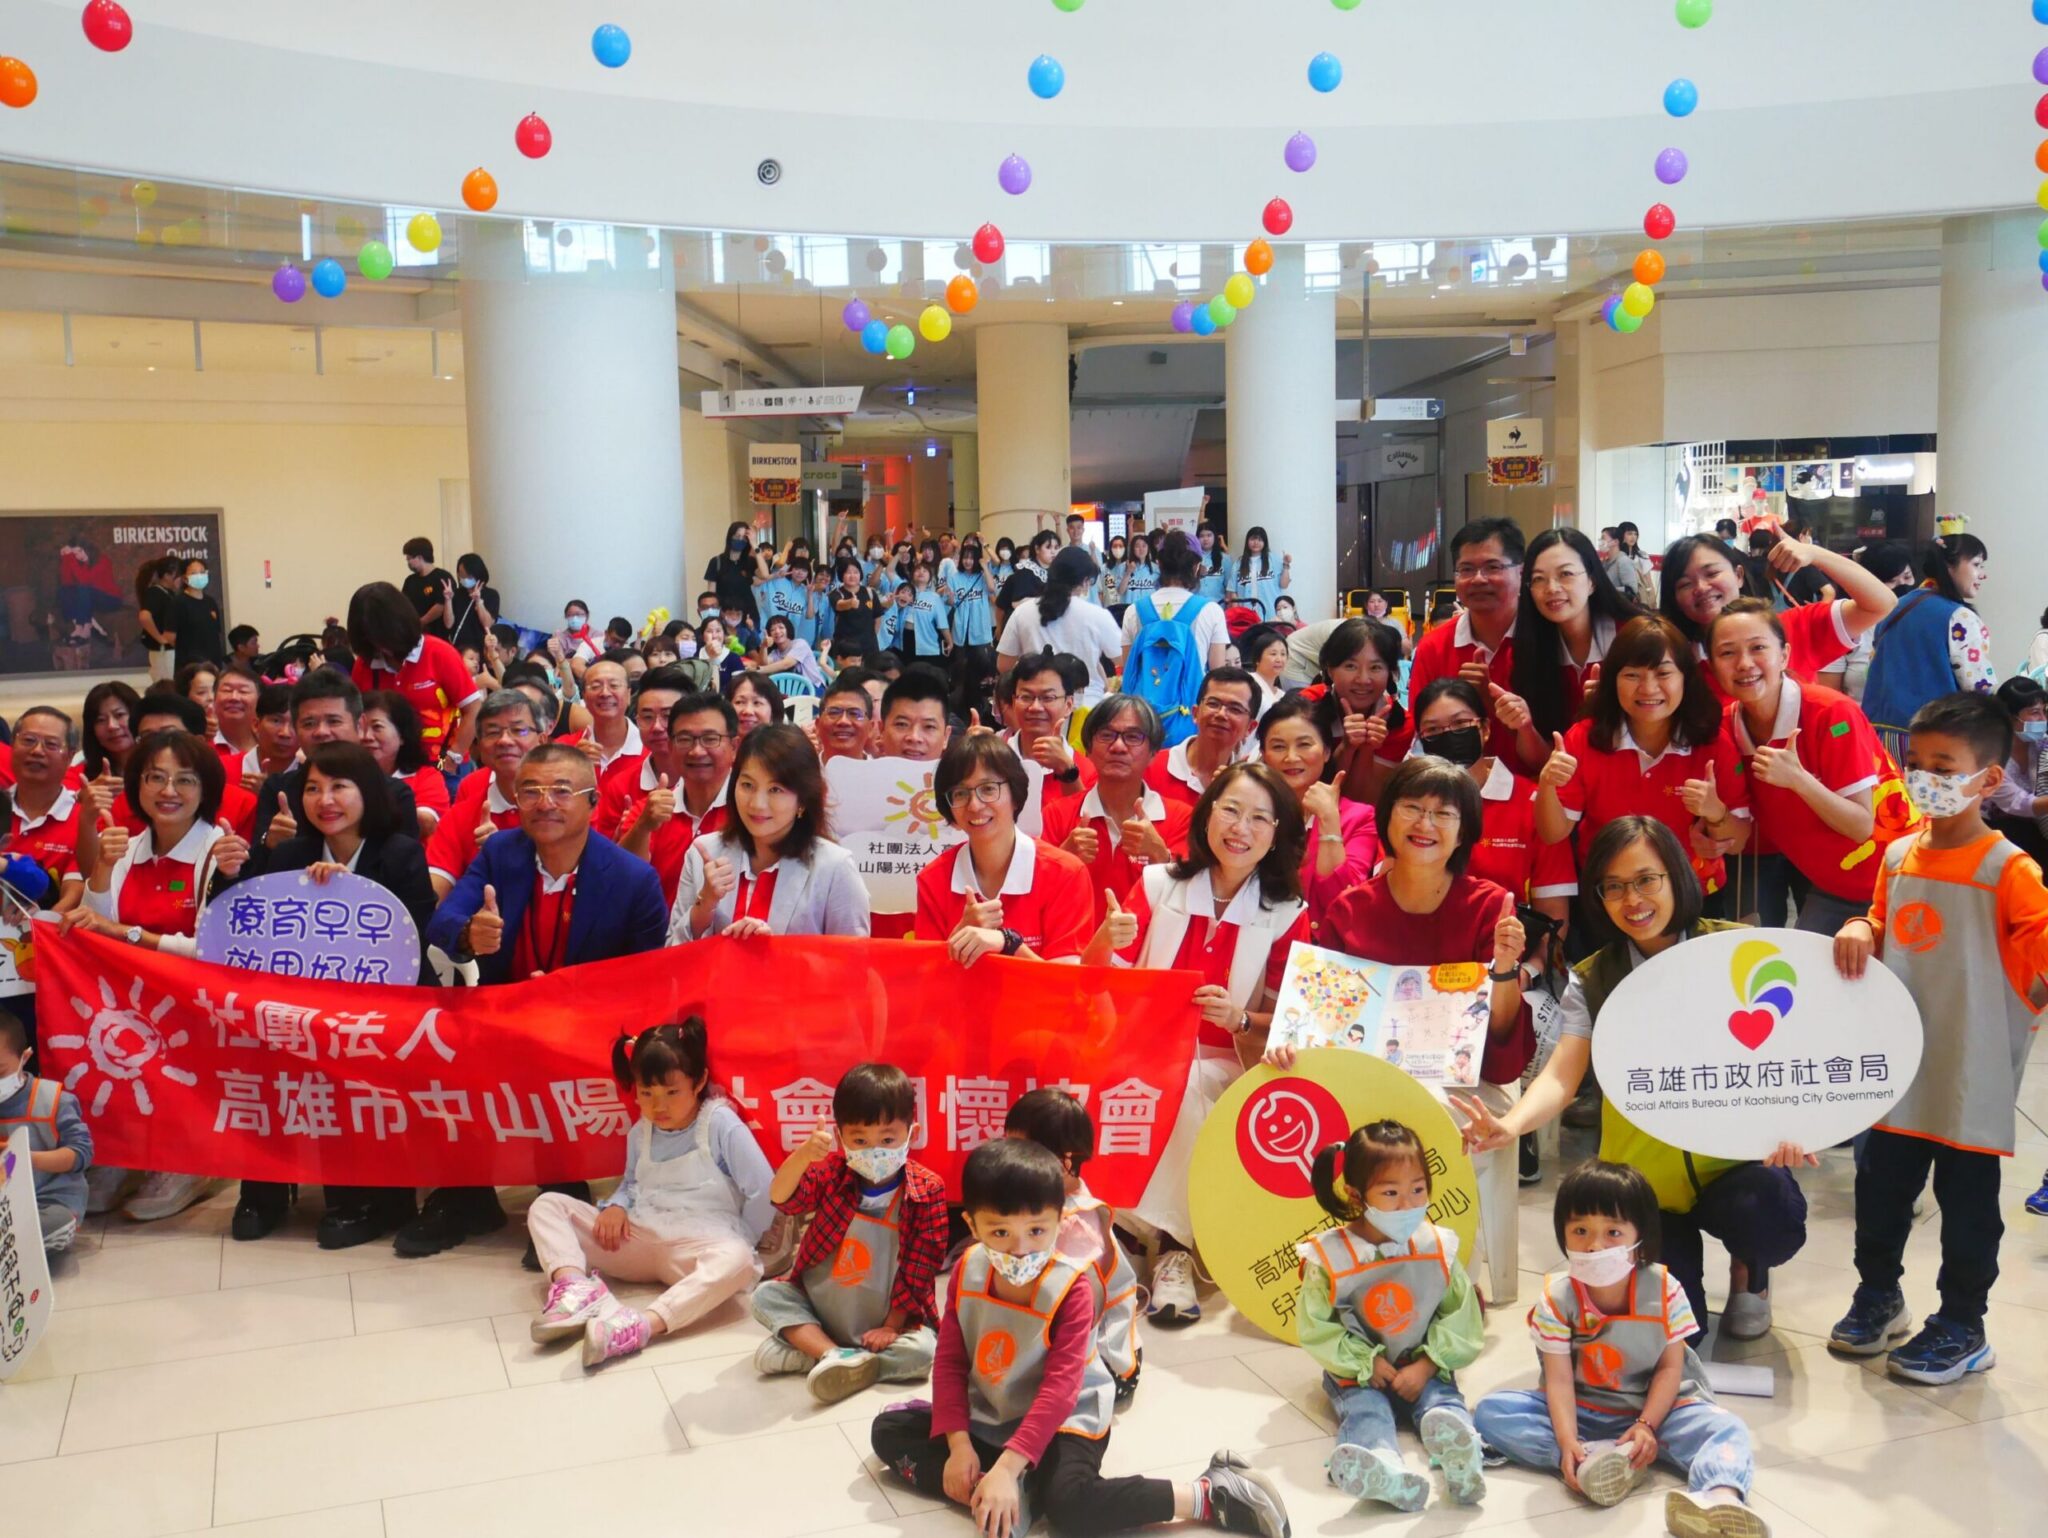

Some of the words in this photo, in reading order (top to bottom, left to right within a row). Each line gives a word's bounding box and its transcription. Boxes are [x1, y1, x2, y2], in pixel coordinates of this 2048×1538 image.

[752, 456, 798, 466] BIRKENSTOCK
[803, 472, 838, 480] crocs
[113, 526, 208, 544] BIRKENSTOCK
[166, 548, 208, 560] Outlet
[229, 895, 392, 945] 療育早早
[193, 987, 457, 1063] 社團法人
[1626, 1054, 1889, 1095] 高雄市政府社會局
[1625, 1101, 1656, 1111] Social
[1658, 1100, 1689, 1110] Affairs
[1692, 1098, 1728, 1108] Bureau
[1731, 1096, 1741, 1106] of
[1744, 1094, 1799, 1106] Kaohsiung
[1802, 1092, 1823, 1104] City
[1826, 1089, 1894, 1101] Government
